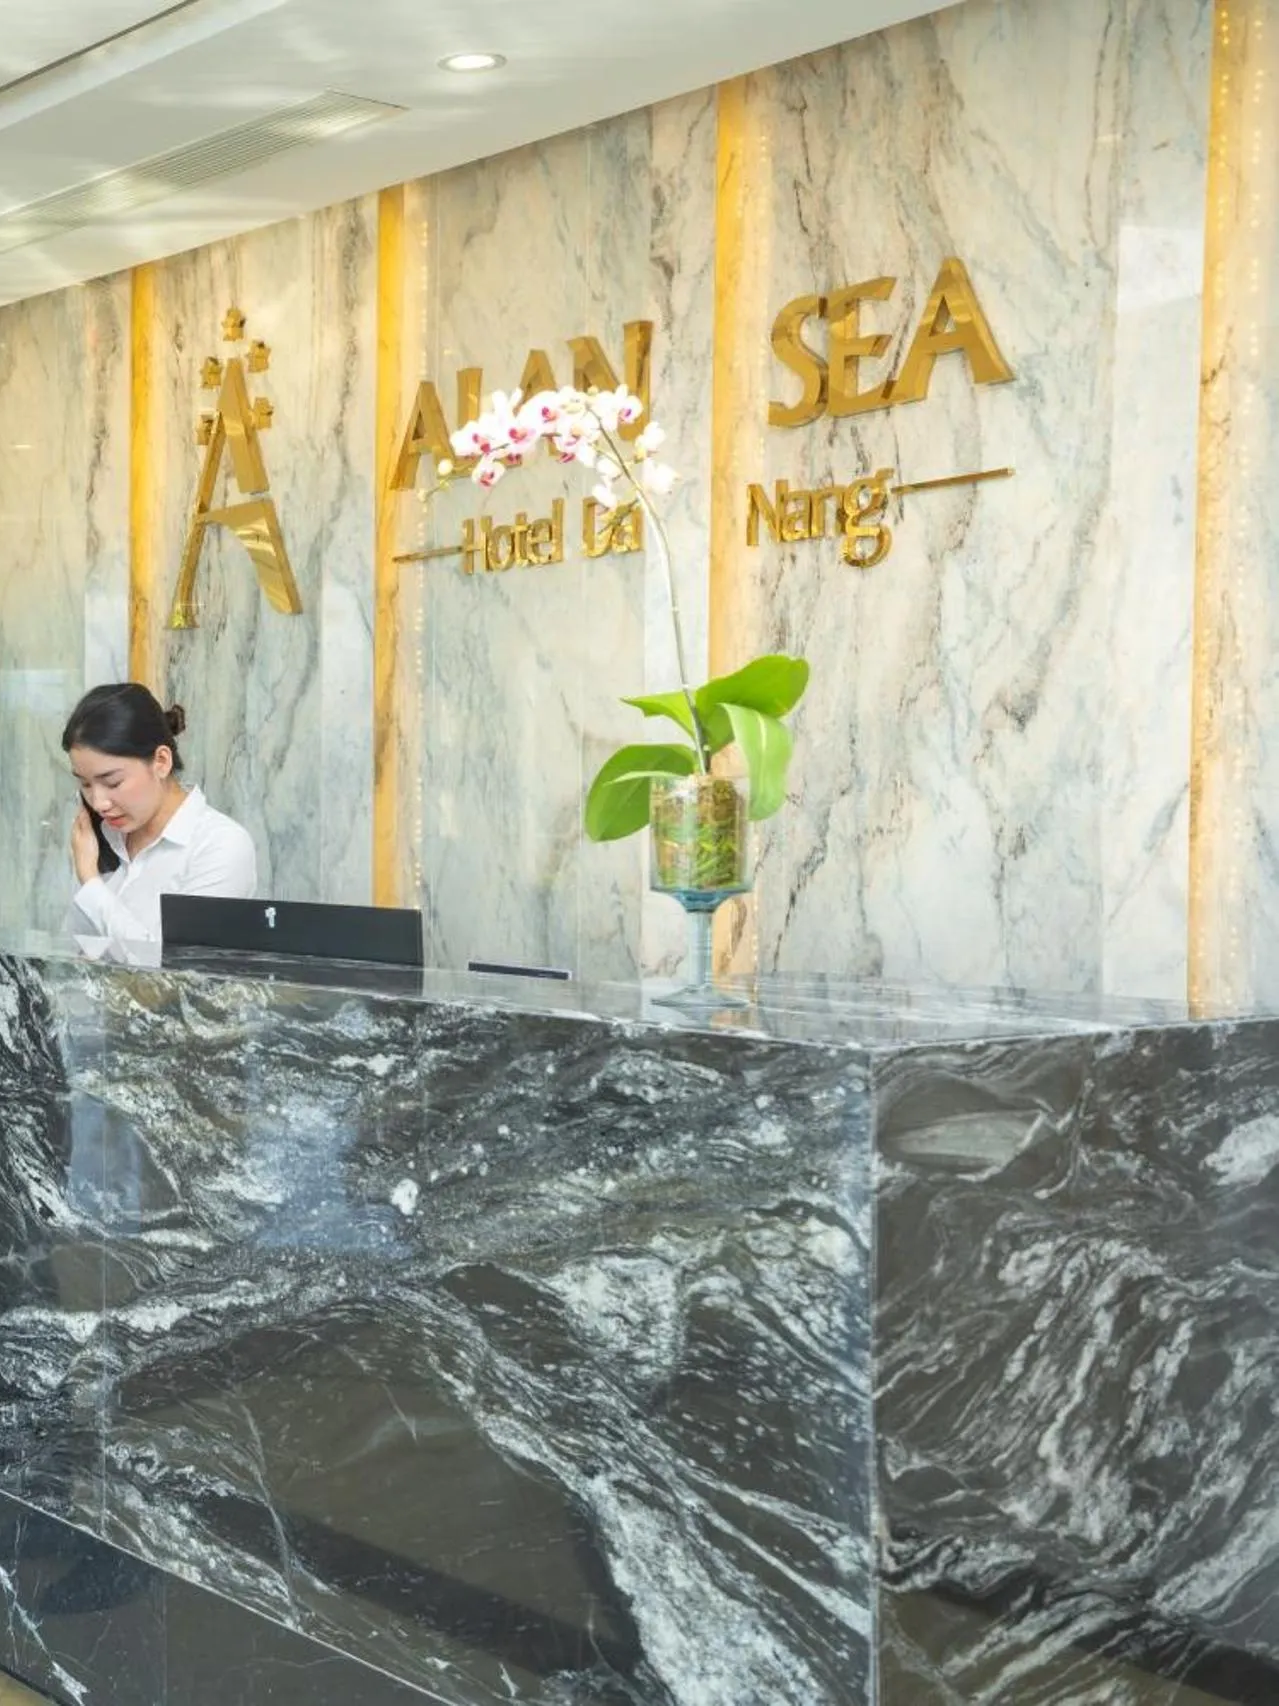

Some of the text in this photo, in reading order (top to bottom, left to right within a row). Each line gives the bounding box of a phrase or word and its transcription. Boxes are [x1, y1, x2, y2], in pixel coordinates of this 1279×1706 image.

[768, 256, 1017, 428] SEA
[462, 497, 565, 575] Hotel
[746, 467, 895, 568] Nang
